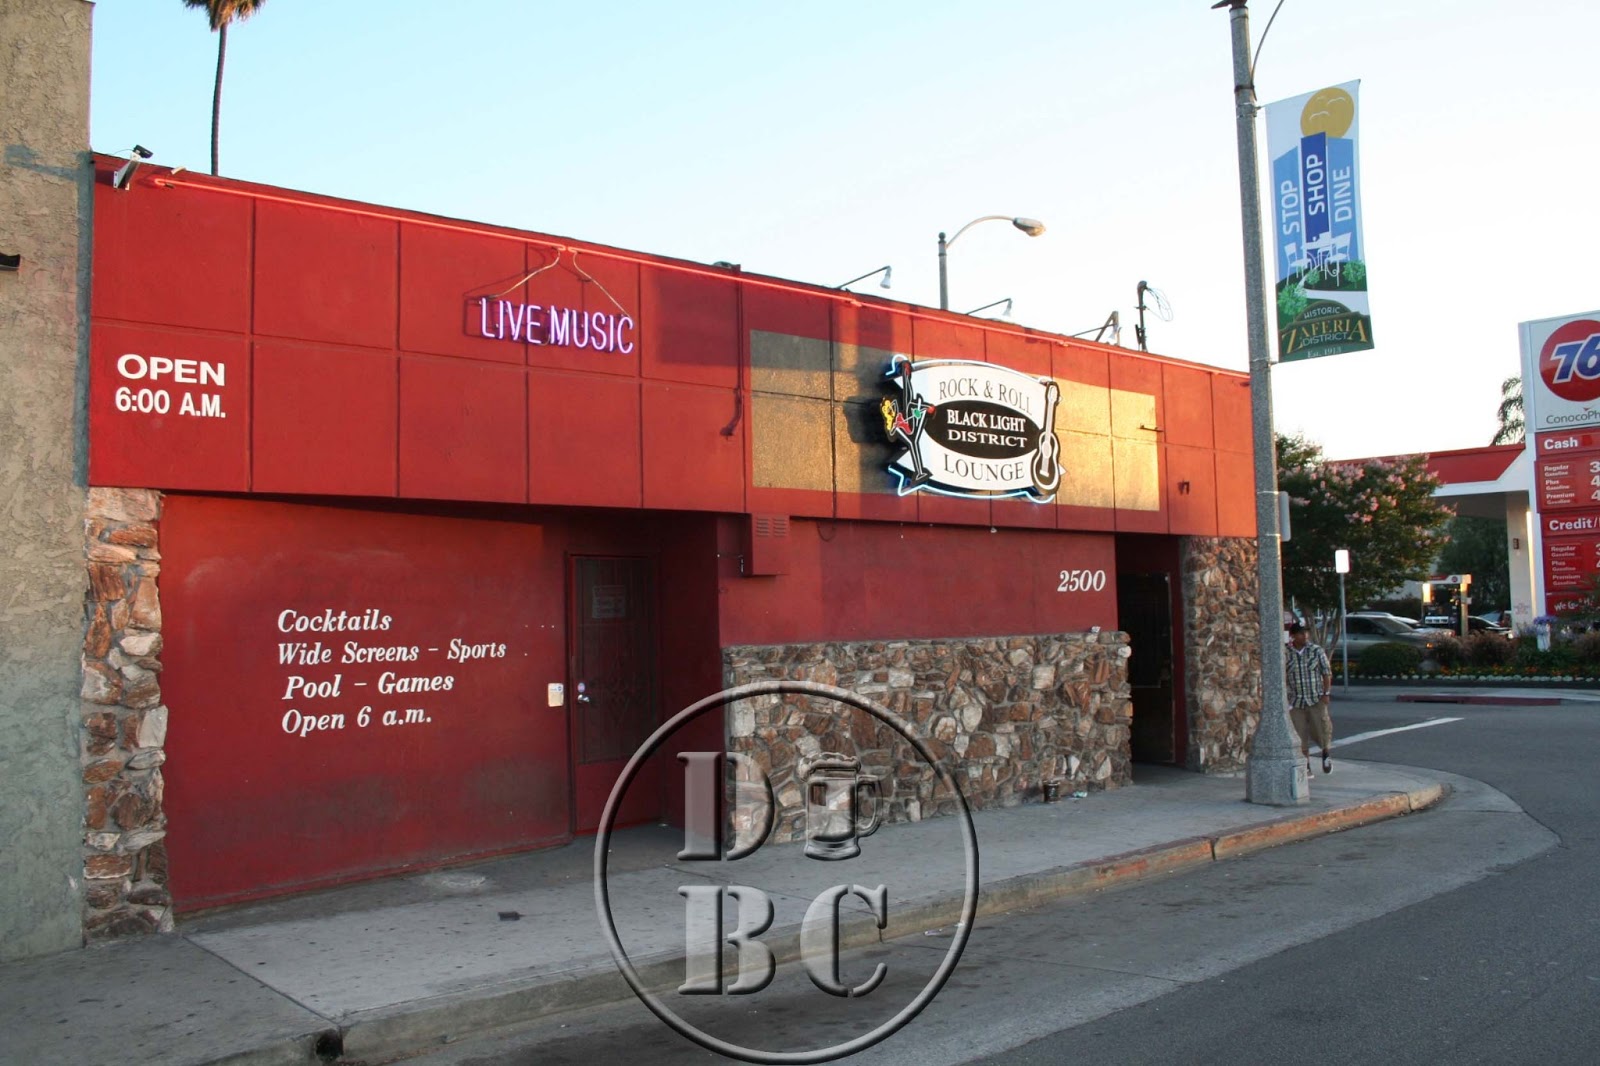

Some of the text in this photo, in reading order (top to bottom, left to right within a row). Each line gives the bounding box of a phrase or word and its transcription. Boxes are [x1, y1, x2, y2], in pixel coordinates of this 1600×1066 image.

[1306, 153, 1325, 217] SHOP
[1332, 165, 1352, 223] DINE
[1280, 179, 1300, 237] STOP
[481, 297, 634, 354] LIVE MUSIC
[1303, 306, 1341, 320] HISTORIC
[1281, 318, 1368, 354] ZAFERIA
[1302, 331, 1348, 347] DISTRICT
[117, 353, 225, 386] OPEN
[1550, 333, 1600, 384] 76
[115, 386, 226, 418] 6:00 A.M.
[939, 377, 1033, 416] ROCK & ROLL
[946, 409, 1026, 433] BLACK LIGHT
[947, 429, 1028, 448] DISTRICT
[1543, 437, 1579, 450] Cash
[943, 453, 1025, 482] LOUNGE
[1544, 464, 1569, 473] Regular
[1546, 492, 1575, 500] Premium
[1057, 569, 1106, 592] 2500
[277, 608, 392, 633] Cocktails
[278, 641, 332, 665] Wide
[341, 641, 419, 664] Screens
[447, 638, 507, 663] Sports
[282, 673, 341, 700] Pool
[378, 671, 454, 695] Games
[282, 705, 432, 738] Open 6 a.m.
